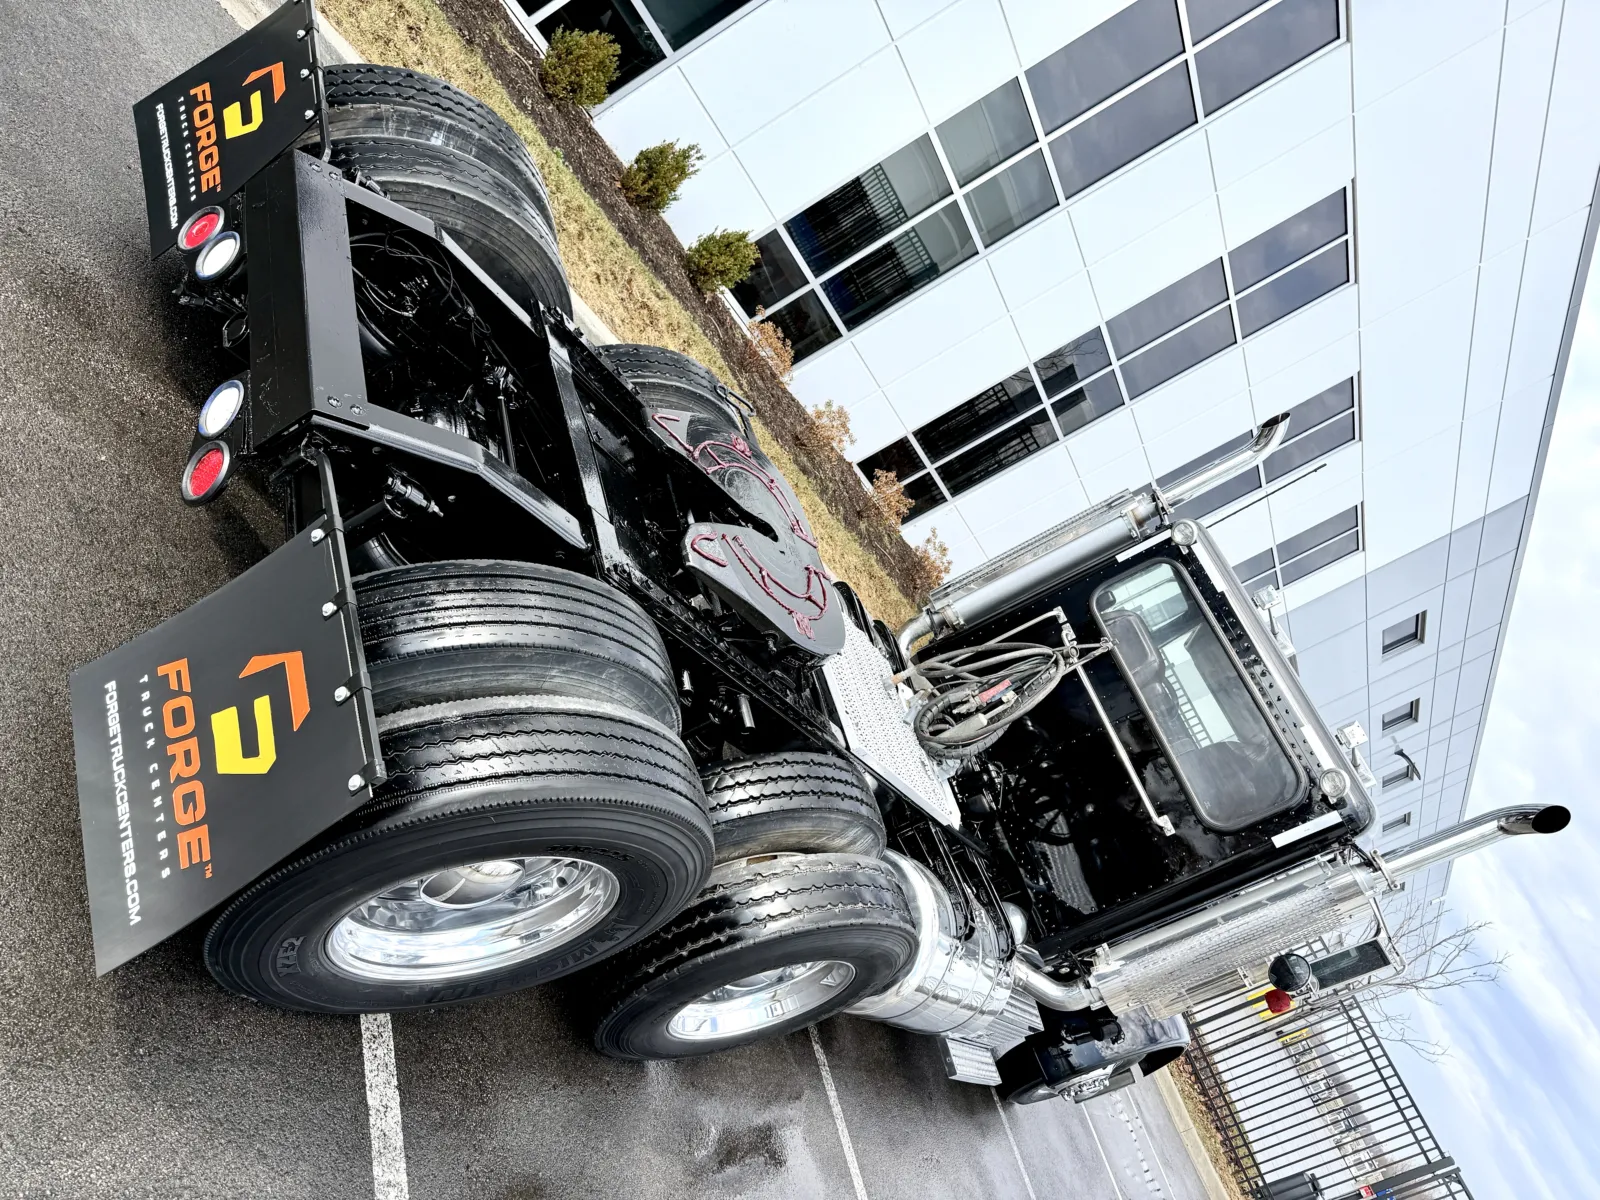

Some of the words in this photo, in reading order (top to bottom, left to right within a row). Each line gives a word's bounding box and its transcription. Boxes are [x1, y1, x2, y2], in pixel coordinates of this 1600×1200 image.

[155, 102, 179, 230] FORGETRUCKCENTERS.COM
[178, 96, 189, 138] TRUCK
[185, 142, 197, 202] CENTERS
[190, 82, 220, 193] FORGE
[103, 680, 142, 926] FORGETRUCKCENTERS.COM
[139, 674, 155, 750] TRUCK
[149, 762, 171, 880] CENTERS
[157, 657, 211, 869] FORGE
